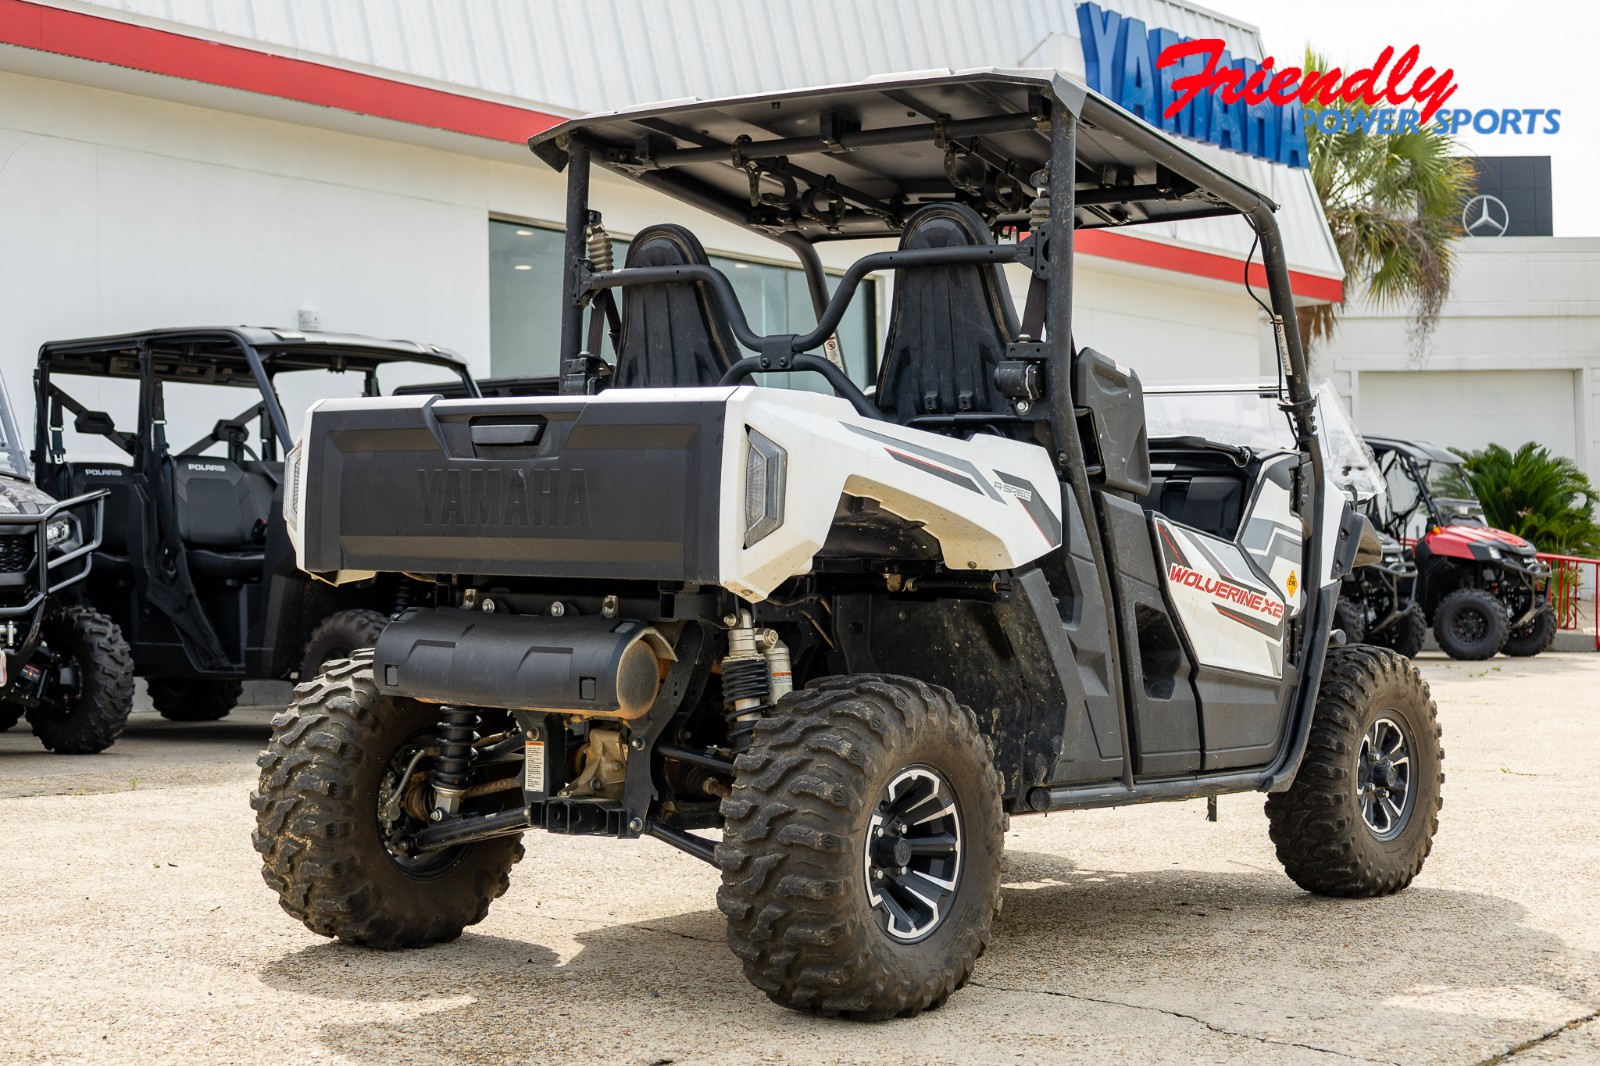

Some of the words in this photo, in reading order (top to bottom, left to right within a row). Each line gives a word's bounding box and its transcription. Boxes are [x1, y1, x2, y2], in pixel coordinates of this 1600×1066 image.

[1076, 1, 1309, 169] YAMAHA
[188, 463, 227, 472] POLARIS
[416, 468, 592, 528] YAMAHA
